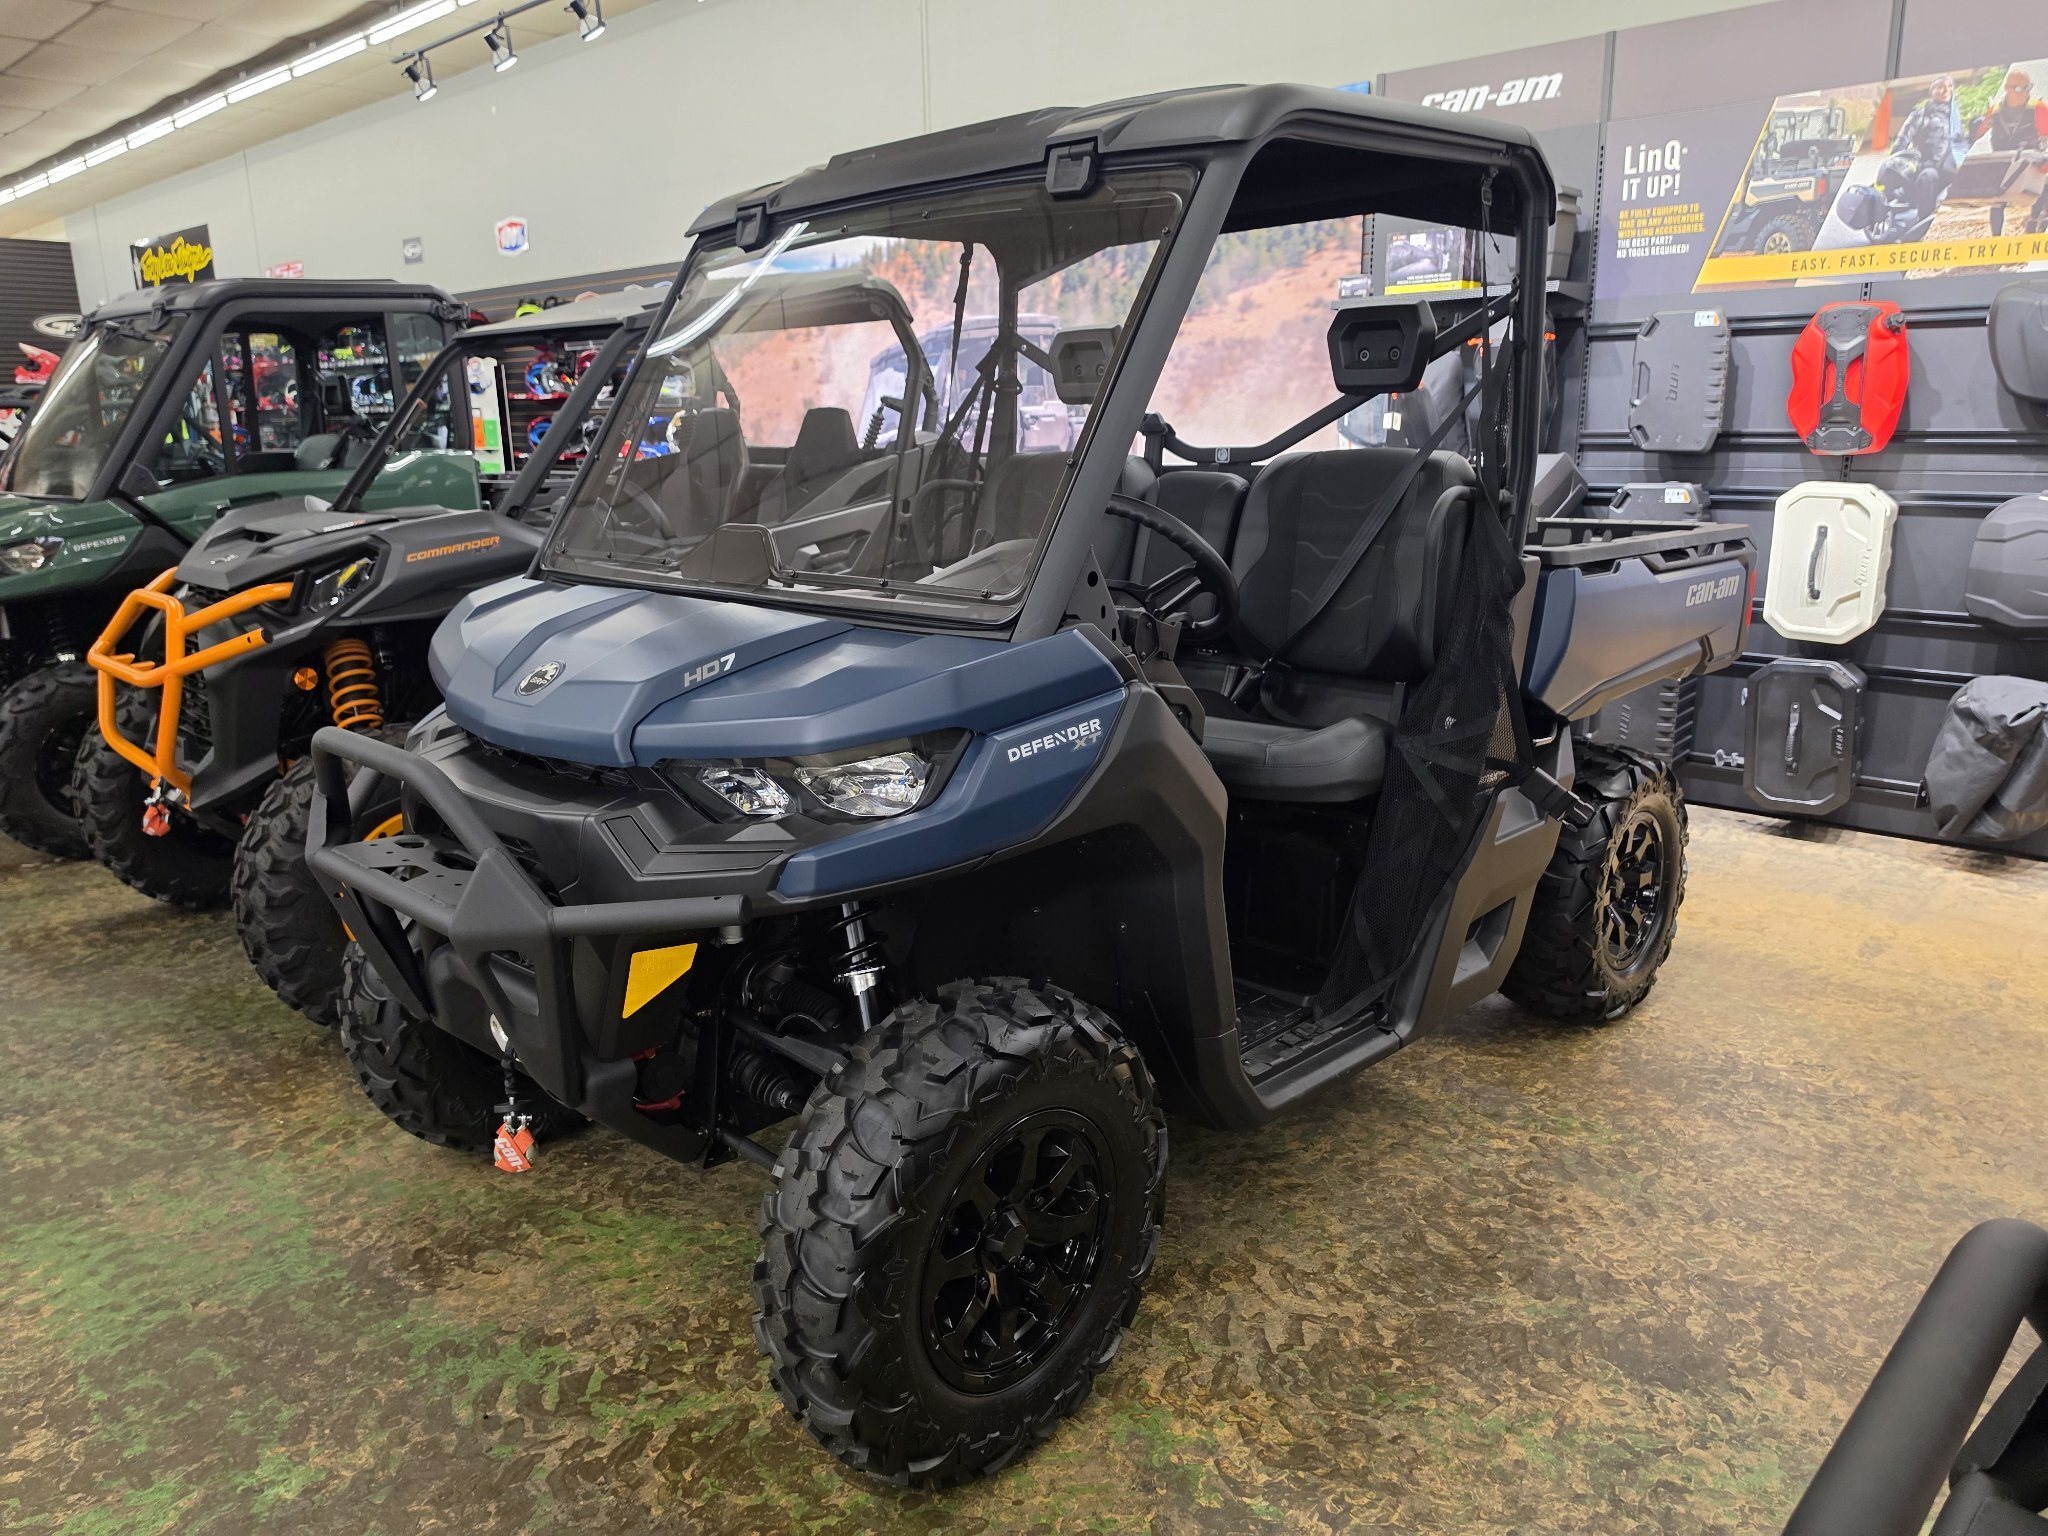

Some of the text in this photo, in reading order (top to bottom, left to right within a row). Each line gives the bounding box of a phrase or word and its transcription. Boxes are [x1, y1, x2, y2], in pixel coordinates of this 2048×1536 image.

[1421, 72, 1563, 113] can-am
[1624, 140, 1681, 175] LinQ
[1622, 173, 1681, 201] IT UP!
[1619, 212, 1705, 229] TAKE ON ANY ADVENTURE
[1631, 207, 1652, 219] FULLY
[1652, 203, 1689, 217] EQUIPPED
[1689, 202, 1700, 213] TO
[1617, 235, 1674, 249] THE BEST PART?
[1618, 229, 1636, 239] WITH
[1655, 222, 1705, 236] ACCESSORIES.
[1616, 244, 1690, 259] NO TOOLS REQUIRED!
[1791, 257, 1831, 273] EASY.
[1840, 253, 1880, 268] FAST.
[1889, 247, 1958, 265] SECURE.
[1968, 244, 1997, 259] TRY
[2007, 241, 2023, 256] IT
[73, 535, 127, 552] DEFENDER
[406, 535, 500, 563] COMMANDER
[1685, 574, 1740, 607] can-am
[530, 676, 548, 685] BRP
[684, 652, 736, 688] HD7
[1007, 718, 1102, 762] DEFENDER
[1071, 731, 1102, 753] XT
